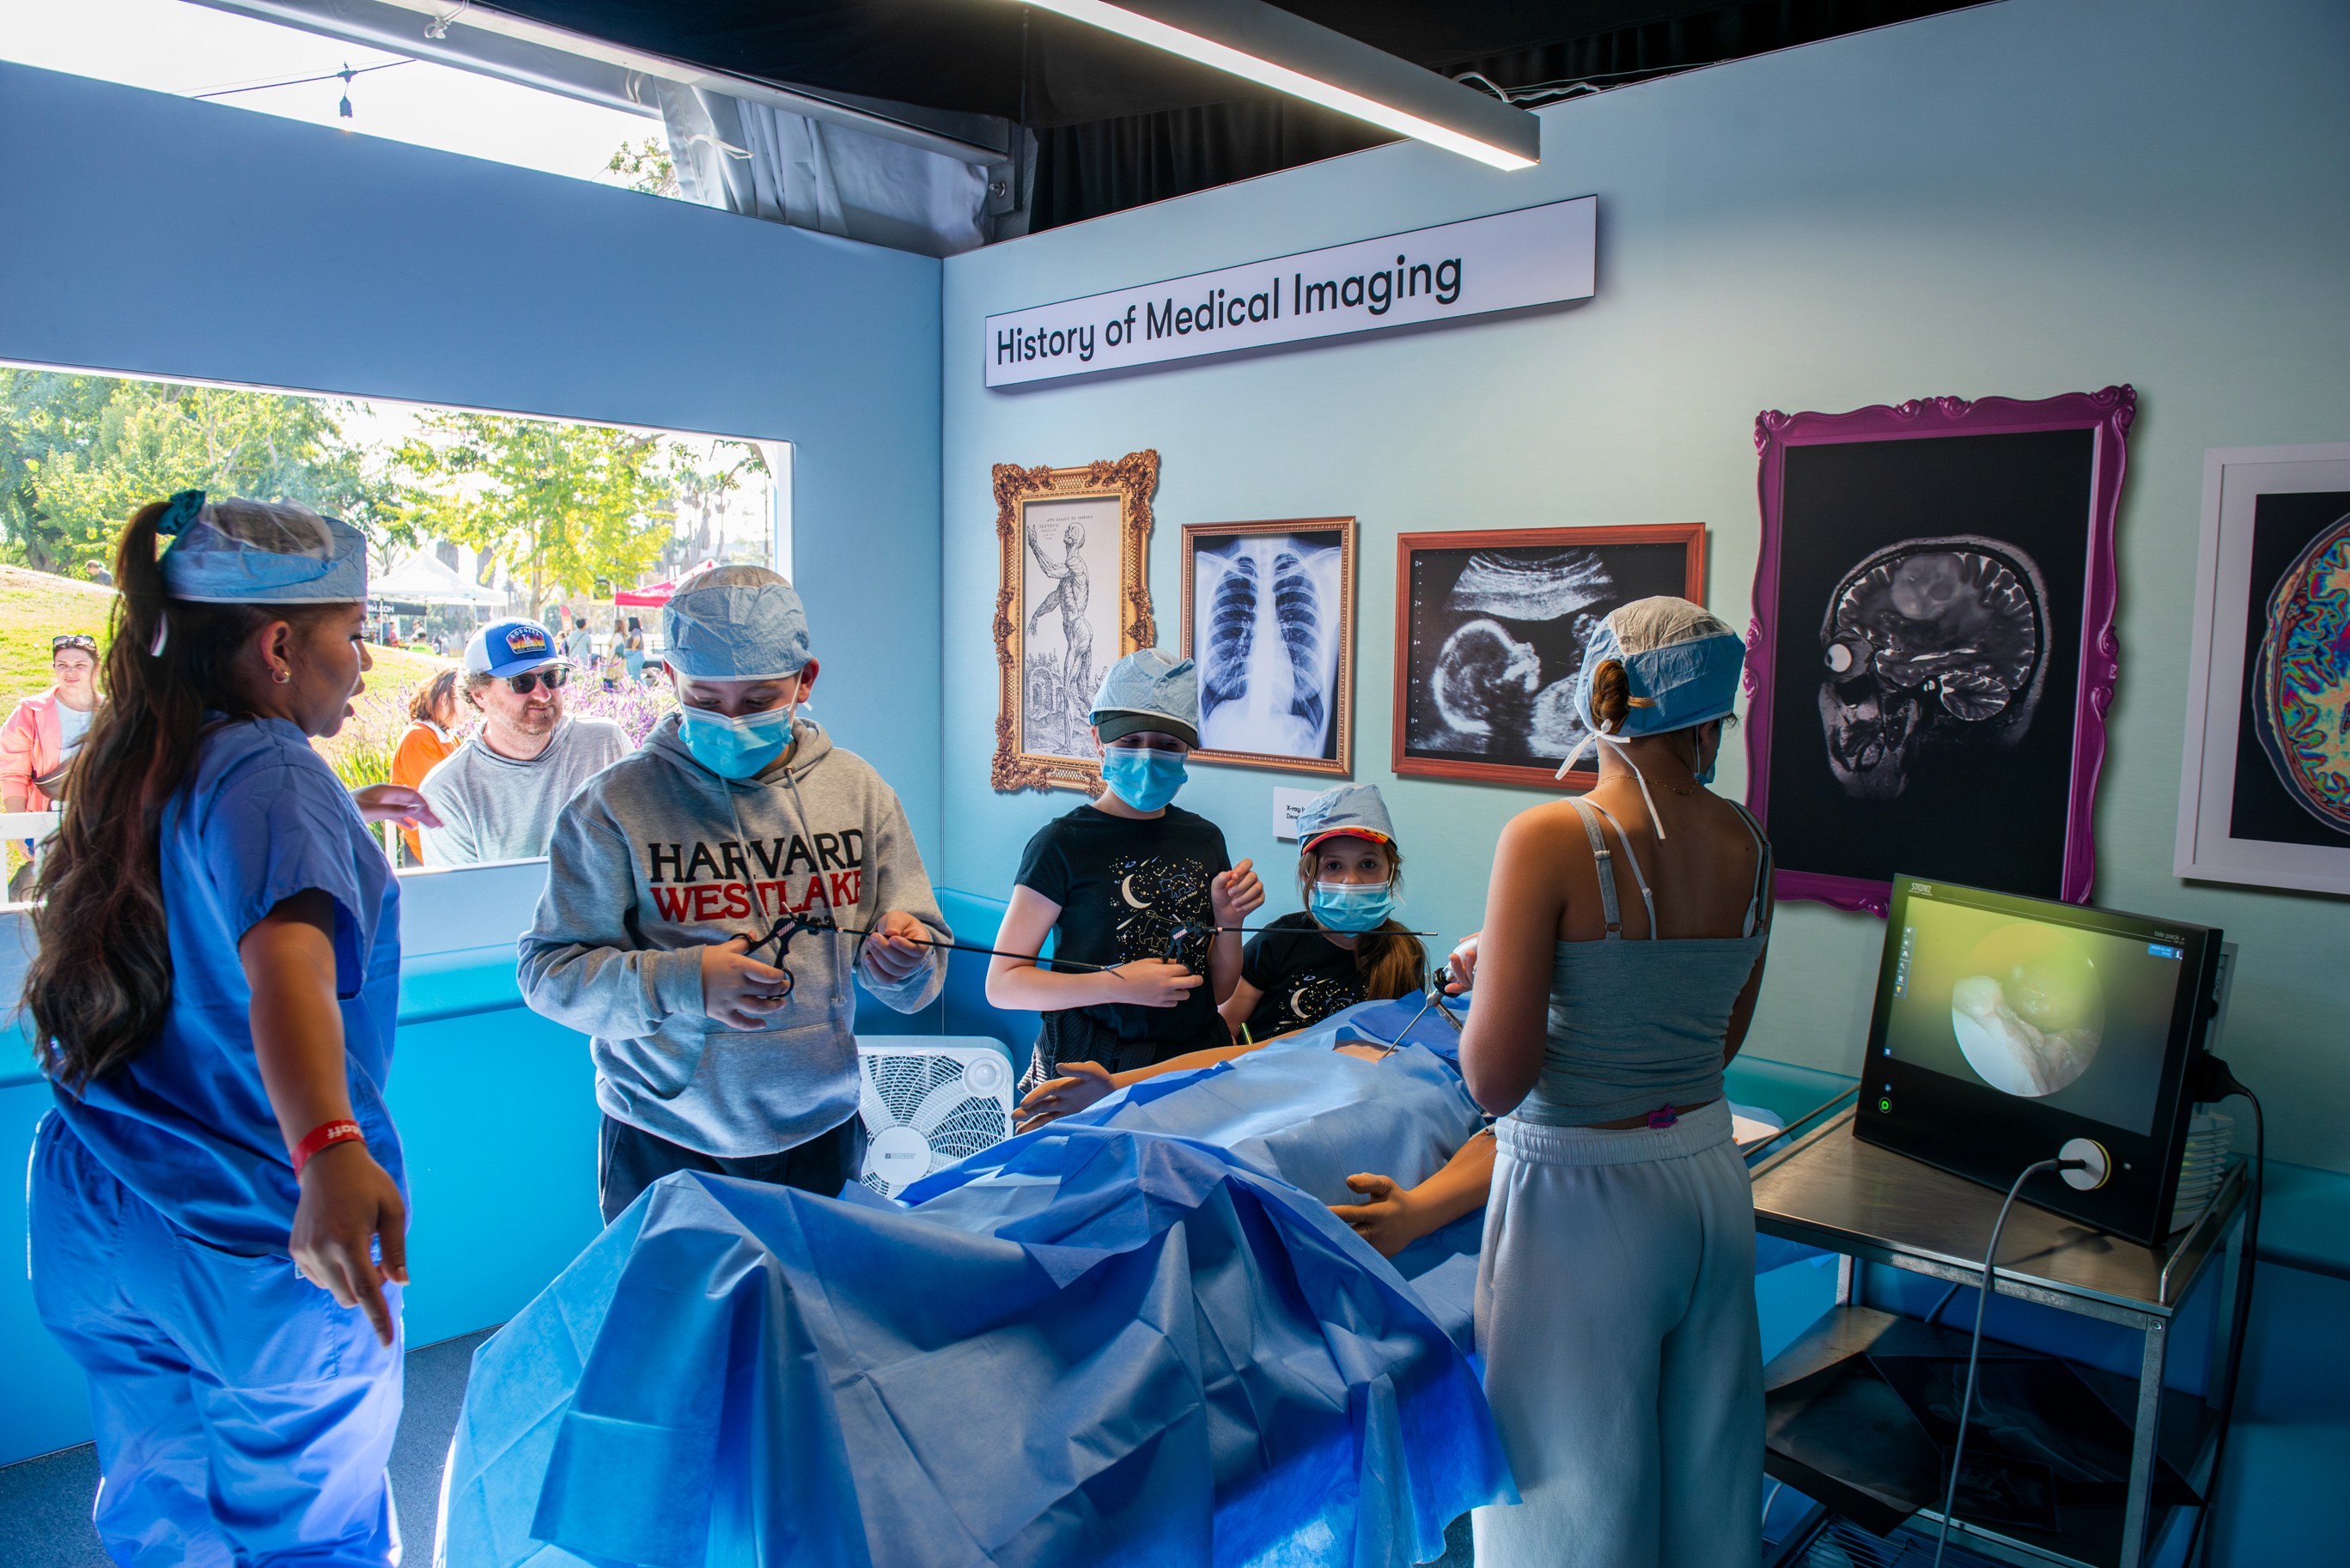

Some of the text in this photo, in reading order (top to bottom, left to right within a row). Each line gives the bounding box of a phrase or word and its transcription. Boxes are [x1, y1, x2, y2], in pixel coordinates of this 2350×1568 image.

[997, 254, 1463, 366] History of Medical Imaging
[510, 628, 540, 639] DODGERS
[1286, 805, 1301, 814] X-ray
[648, 829, 863, 883] HARVARD
[1911, 883, 1932, 893] STORZ
